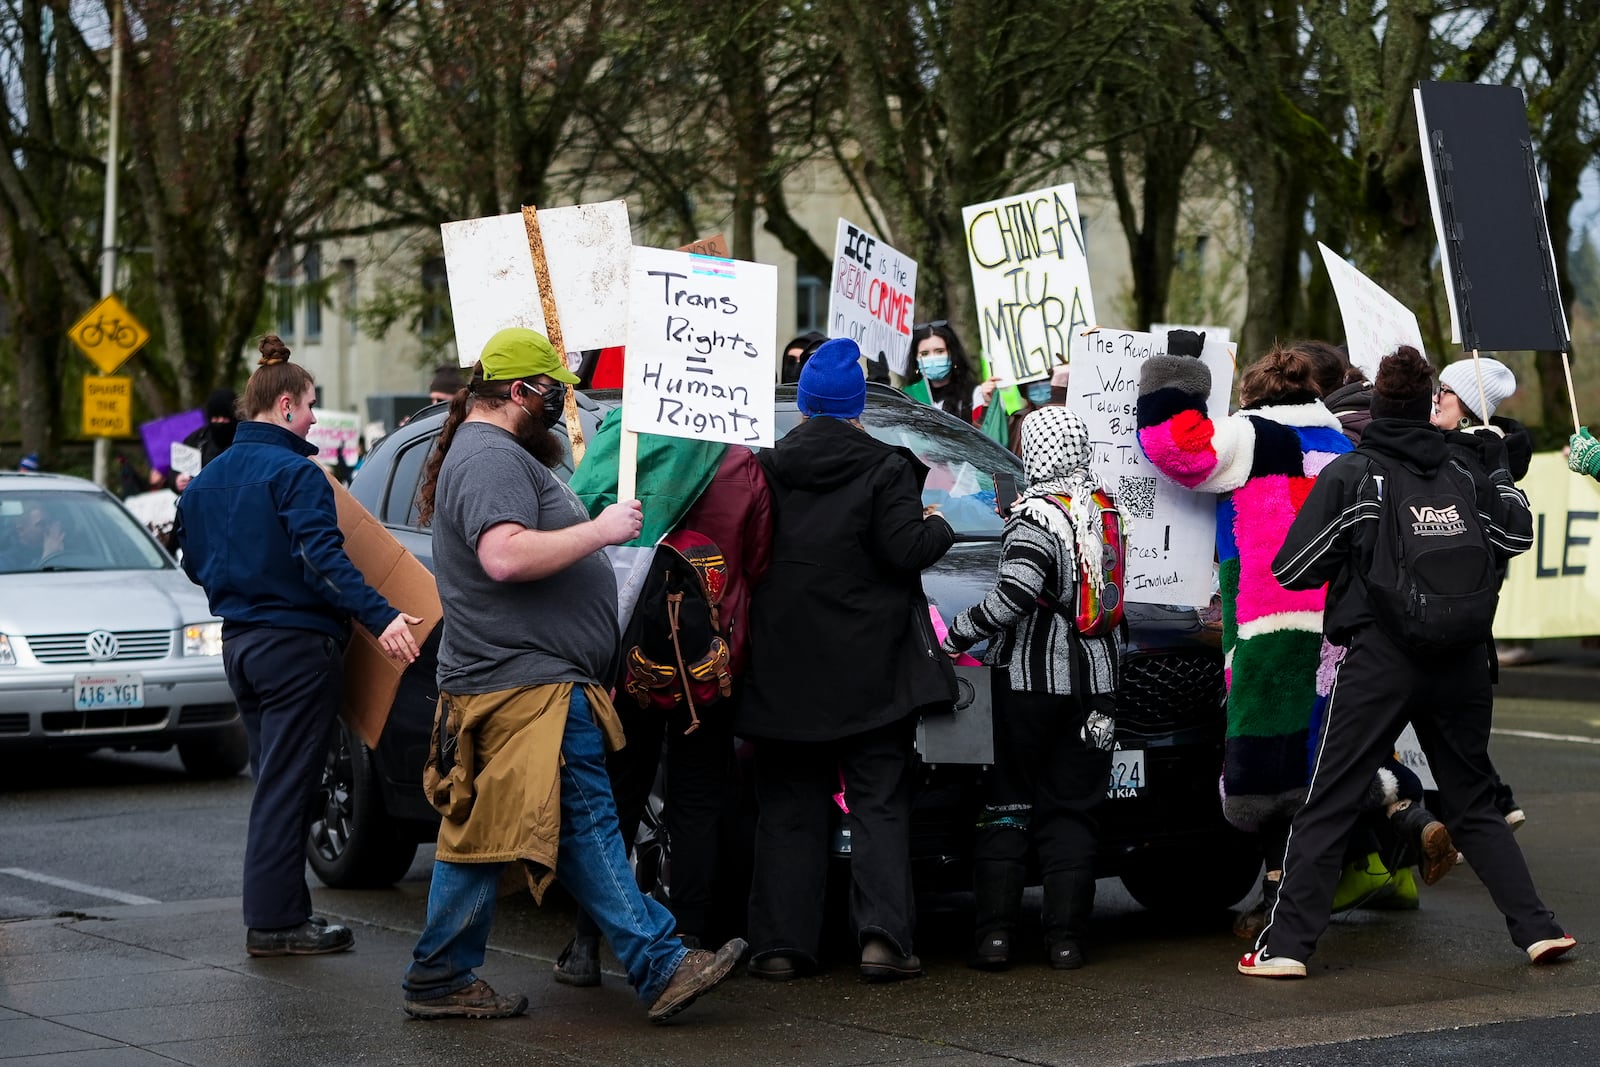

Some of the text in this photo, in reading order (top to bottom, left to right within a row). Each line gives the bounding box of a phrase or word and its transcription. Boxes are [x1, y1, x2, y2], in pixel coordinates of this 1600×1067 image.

[969, 192, 1086, 269] CHINGA
[844, 225, 908, 288] ICE is the
[648, 271, 738, 314] Trans
[836, 256, 914, 337] REAL CRIME
[666, 315, 758, 358] Rights
[835, 307, 845, 334] in
[850, 319, 867, 347] our
[984, 287, 1088, 381] MIGRA
[1083, 330, 1114, 354] The
[686, 356, 713, 375] =
[89, 384, 128, 395] SHARE
[643, 362, 749, 406] Human
[96, 400, 118, 412] THE
[91, 417, 124, 429] ROAD
[1109, 417, 1135, 436] But
[1090, 441, 1139, 464] Tik Tok
[1410, 504, 1460, 524] VANS
[1536, 510, 1599, 578] LE
[1133, 571, 1184, 590] Involved.
